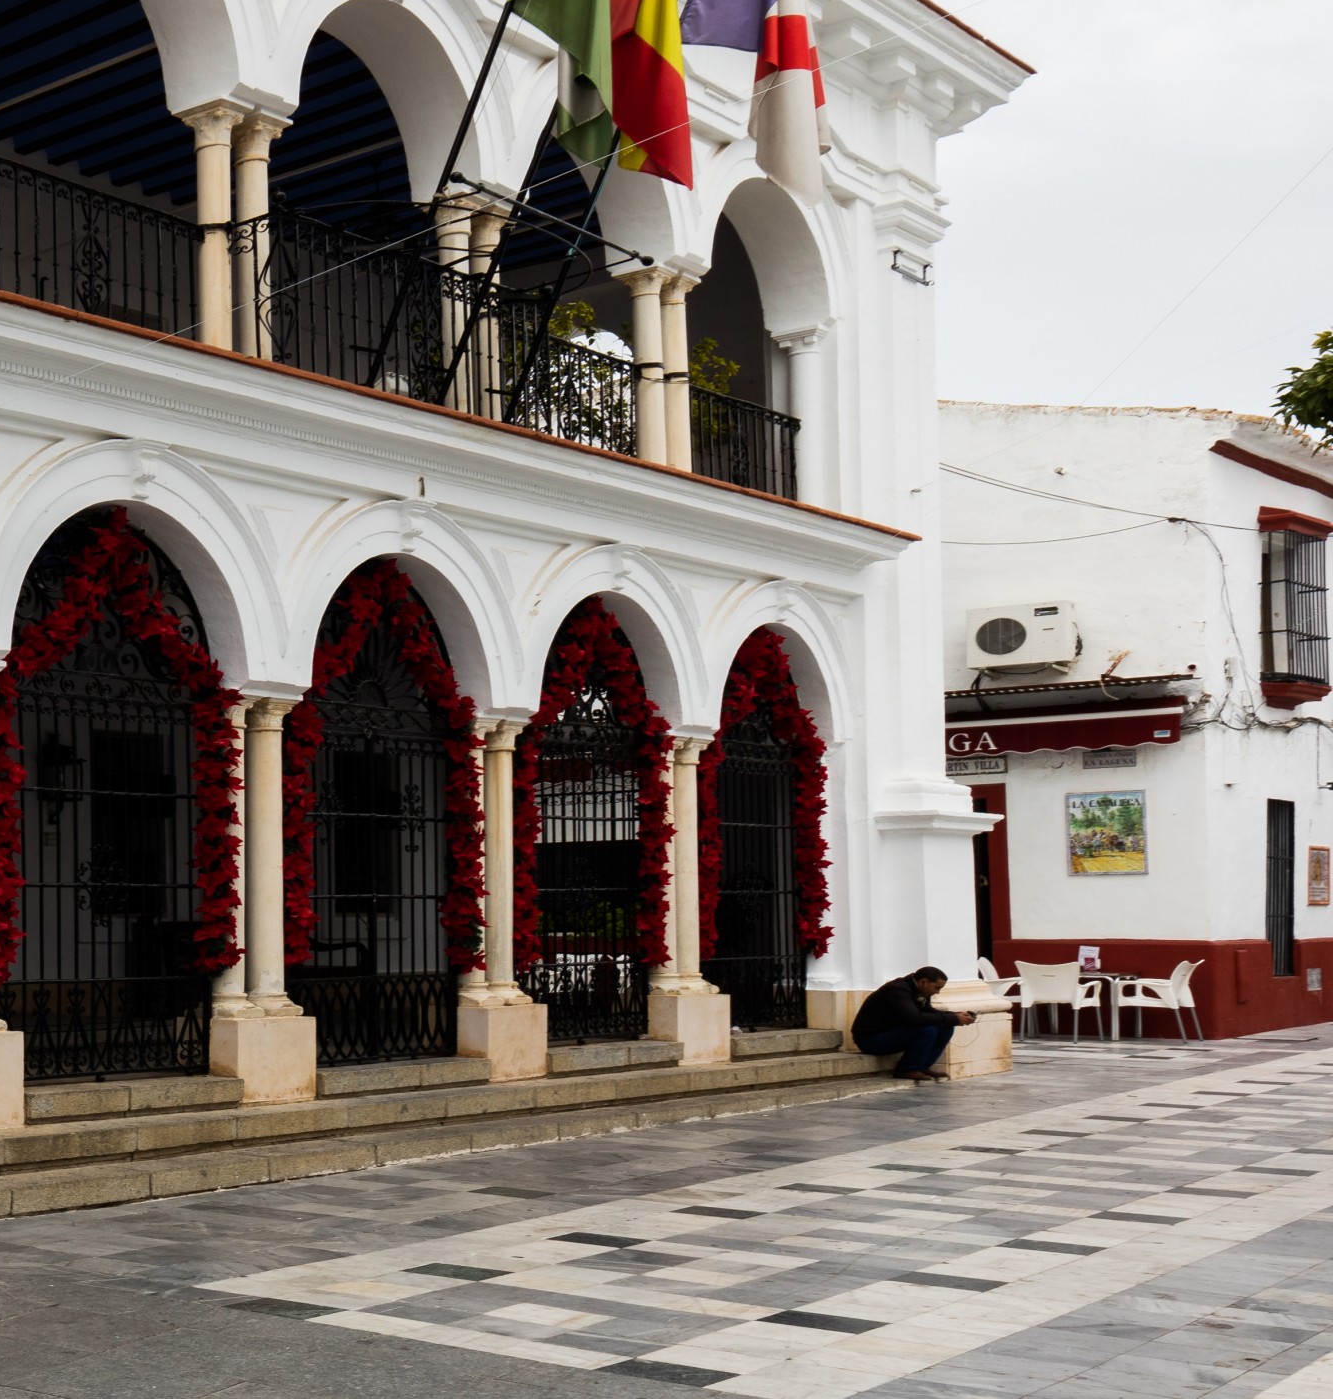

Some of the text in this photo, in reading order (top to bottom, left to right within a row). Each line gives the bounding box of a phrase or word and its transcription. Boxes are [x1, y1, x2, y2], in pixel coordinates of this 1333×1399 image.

[948, 732, 999, 752] GA
[974, 760, 1000, 771] VILLA
[1072, 801, 1086, 809] LA
